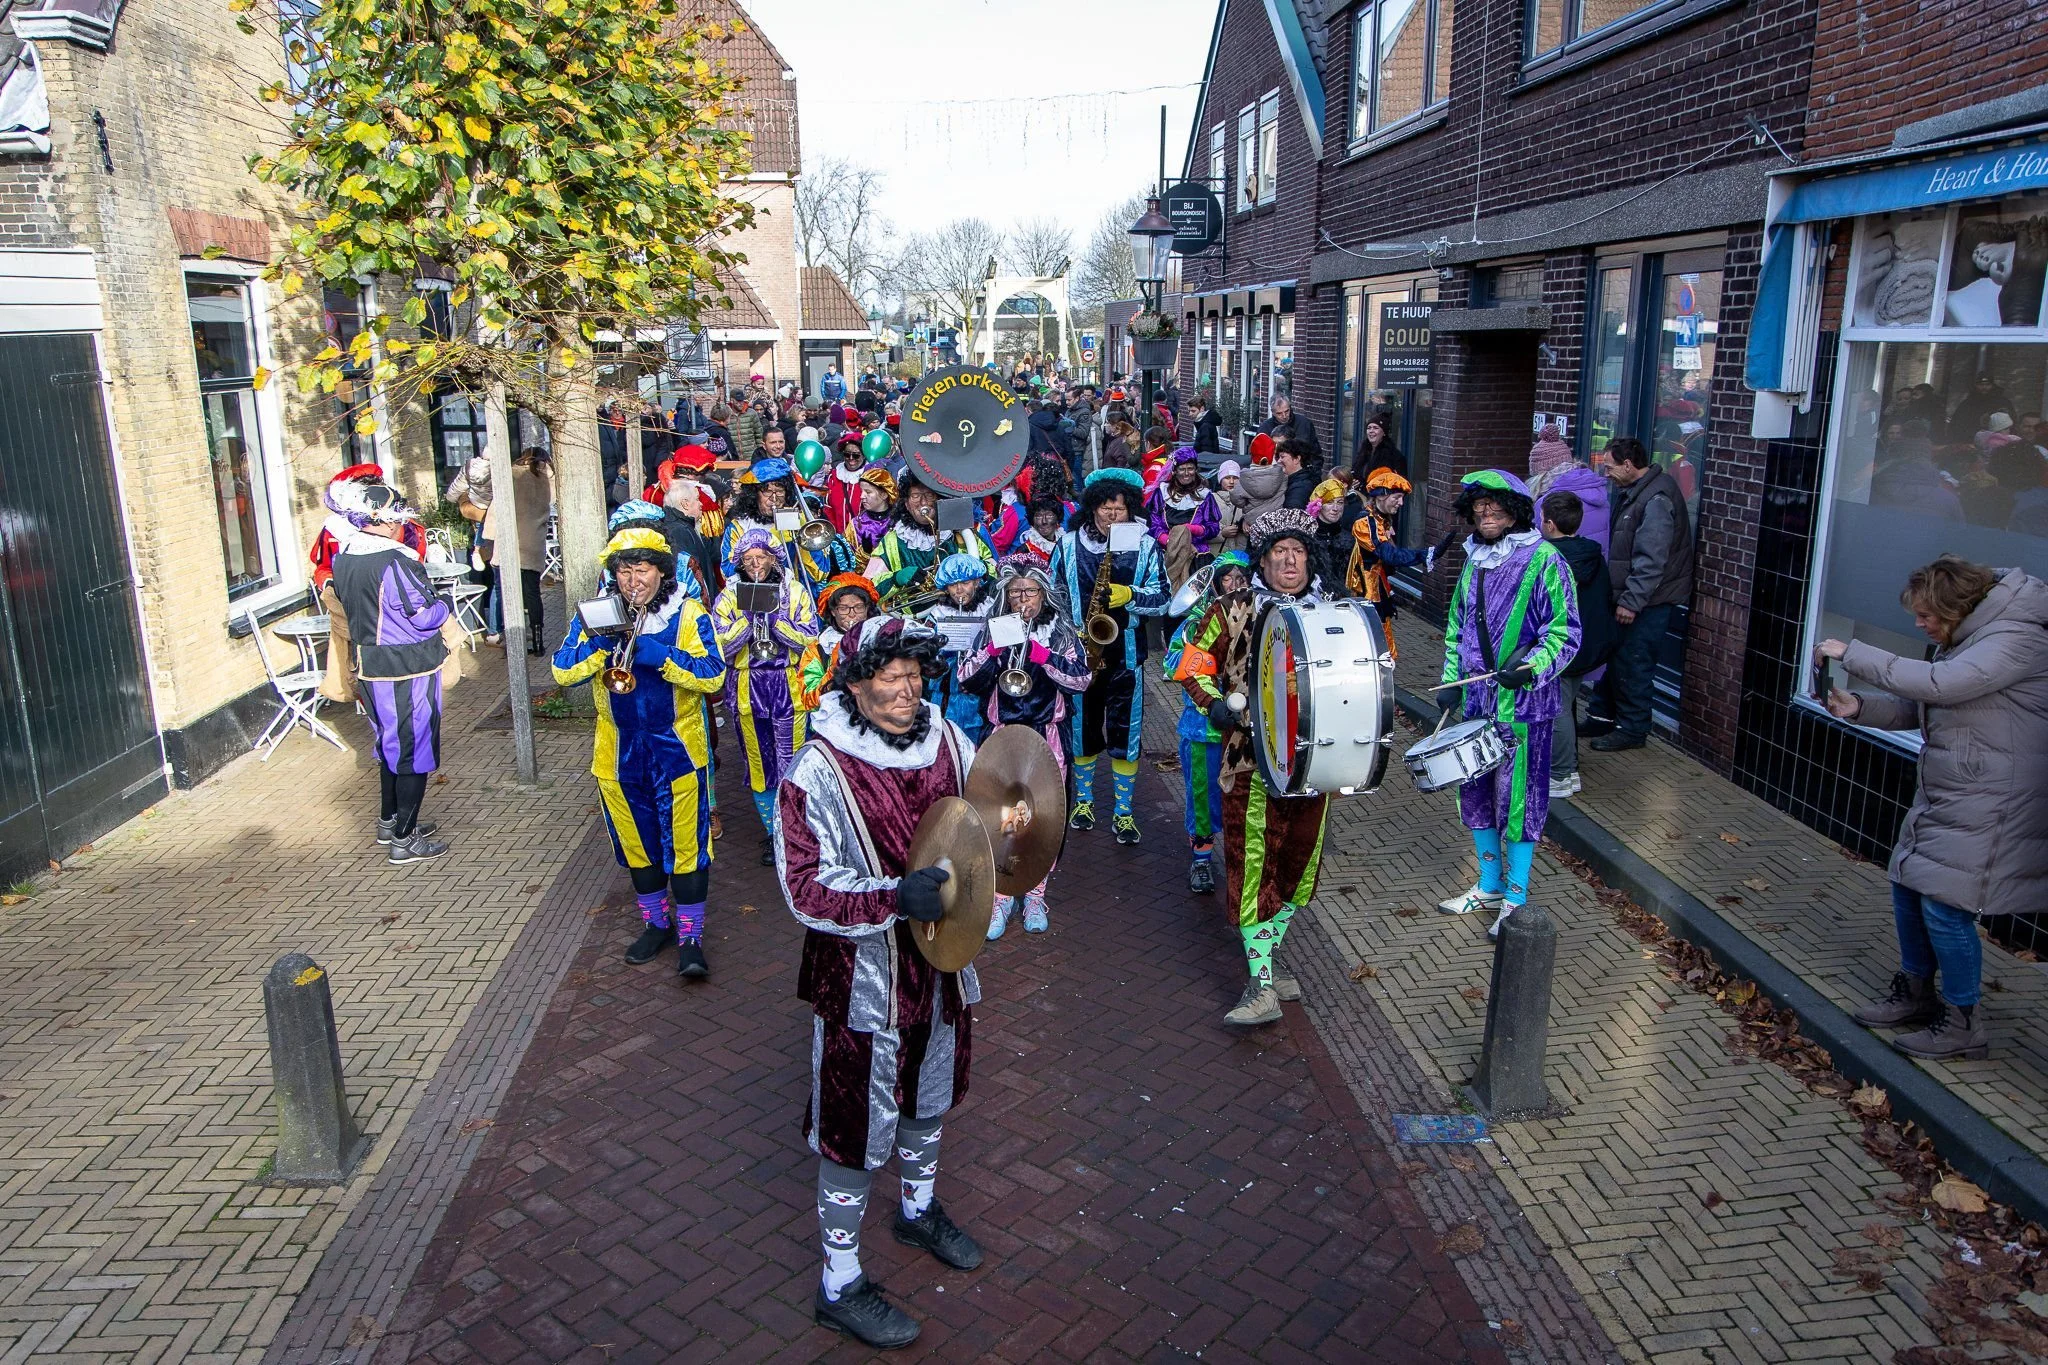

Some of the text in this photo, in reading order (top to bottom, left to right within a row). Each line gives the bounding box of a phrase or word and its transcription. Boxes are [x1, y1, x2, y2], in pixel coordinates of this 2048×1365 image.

[1925, 165, 1983, 194] Heart
[1984, 156, 2006, 185] &
[1183, 202, 1194, 210] BIJ
[1386, 306, 1432, 319] TE HUUR
[1384, 328, 1431, 346] GOUD
[911, 373, 1016, 423] Pieten orkest
